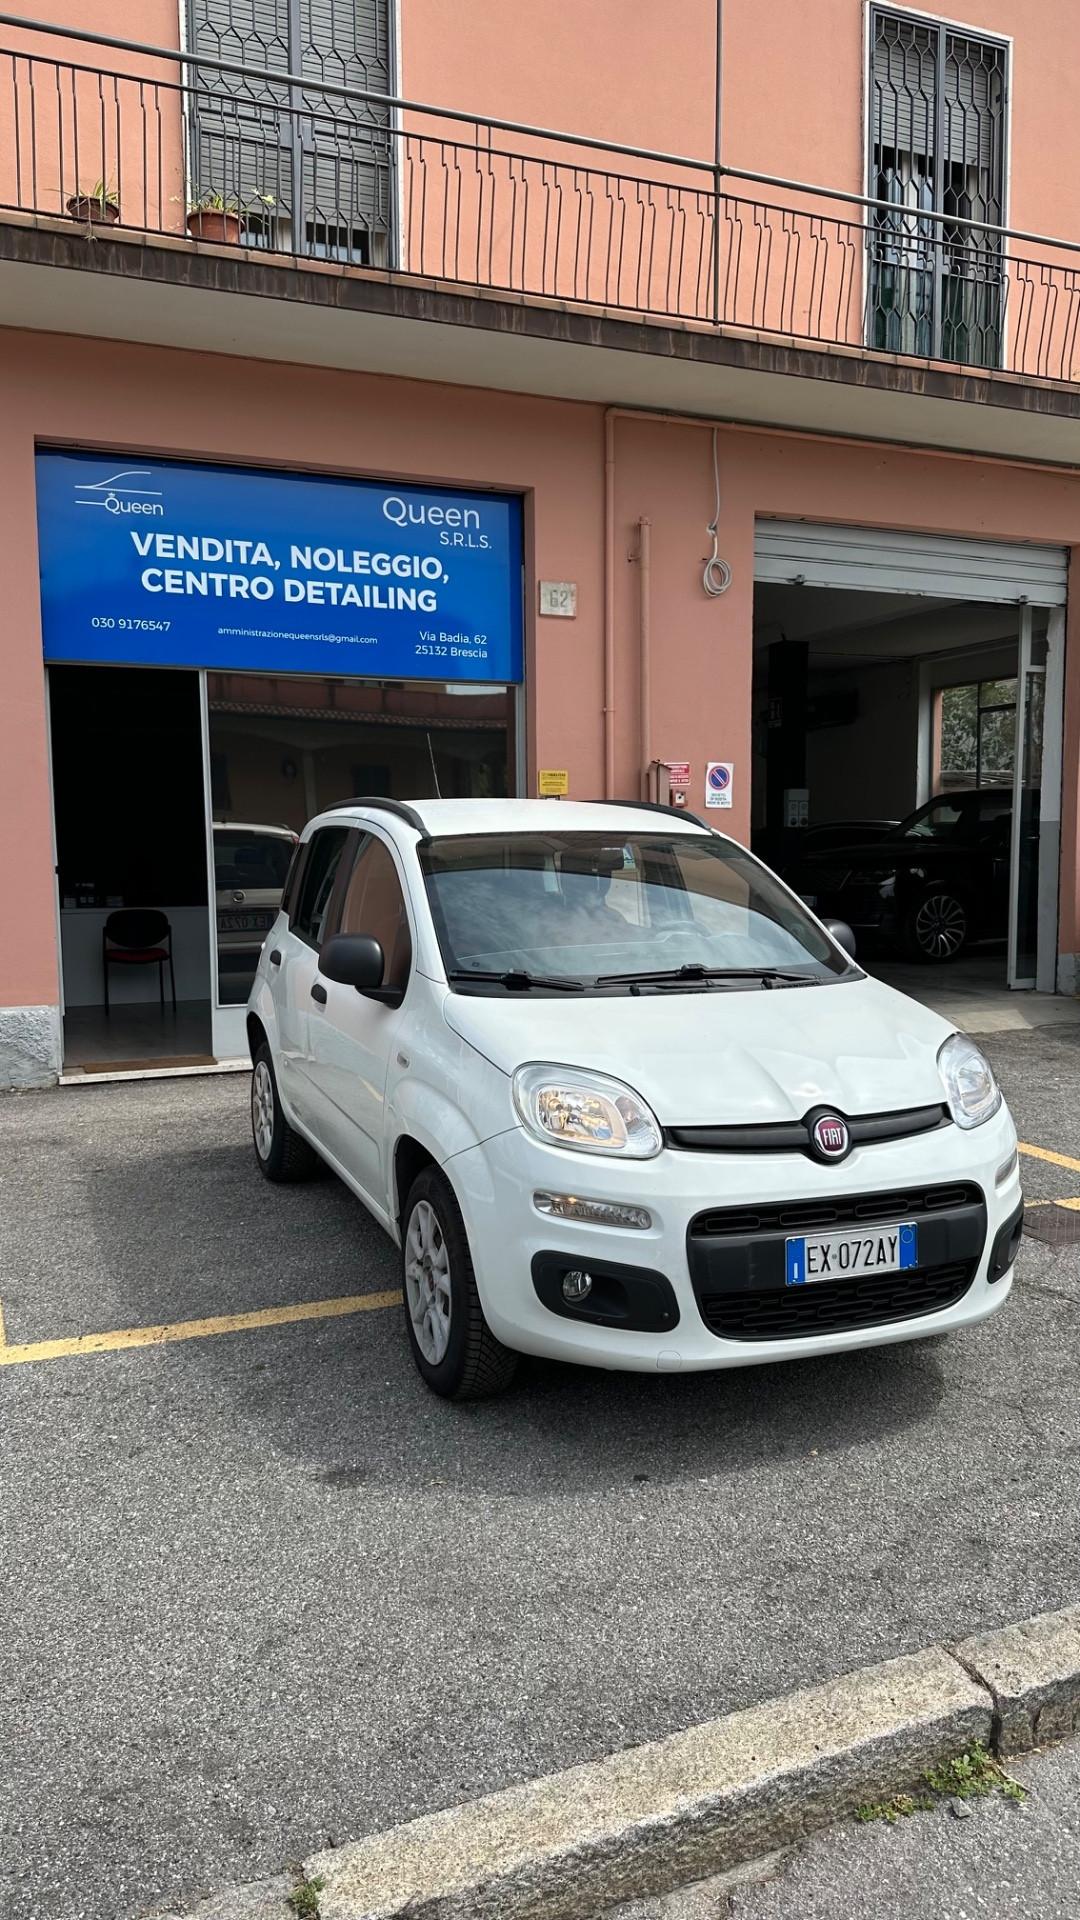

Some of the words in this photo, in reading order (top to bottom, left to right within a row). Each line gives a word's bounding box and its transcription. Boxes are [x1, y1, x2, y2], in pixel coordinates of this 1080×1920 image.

[105, 496, 164, 516] Queen
[382, 496, 480, 529] Queen
[439, 531, 493, 549] S.R.L.S.
[130, 531, 281, 571] VENDITA,
[290, 545, 449, 584] NOLEGGIO,
[141, 567, 275, 601] CENTRO
[284, 578, 437, 612] DETAILING
[91, 617, 115, 628] 030
[118, 618, 171, 632] 9176547
[218, 626, 378, 645] amministrazionequeensrls@gmail.com
[419, 631, 436, 641] Via
[474, 635, 487, 645] 62
[415, 645, 448, 656] 25132
[450, 647, 488, 658] Brescia
[822, 1127, 842, 1146] FIAT
